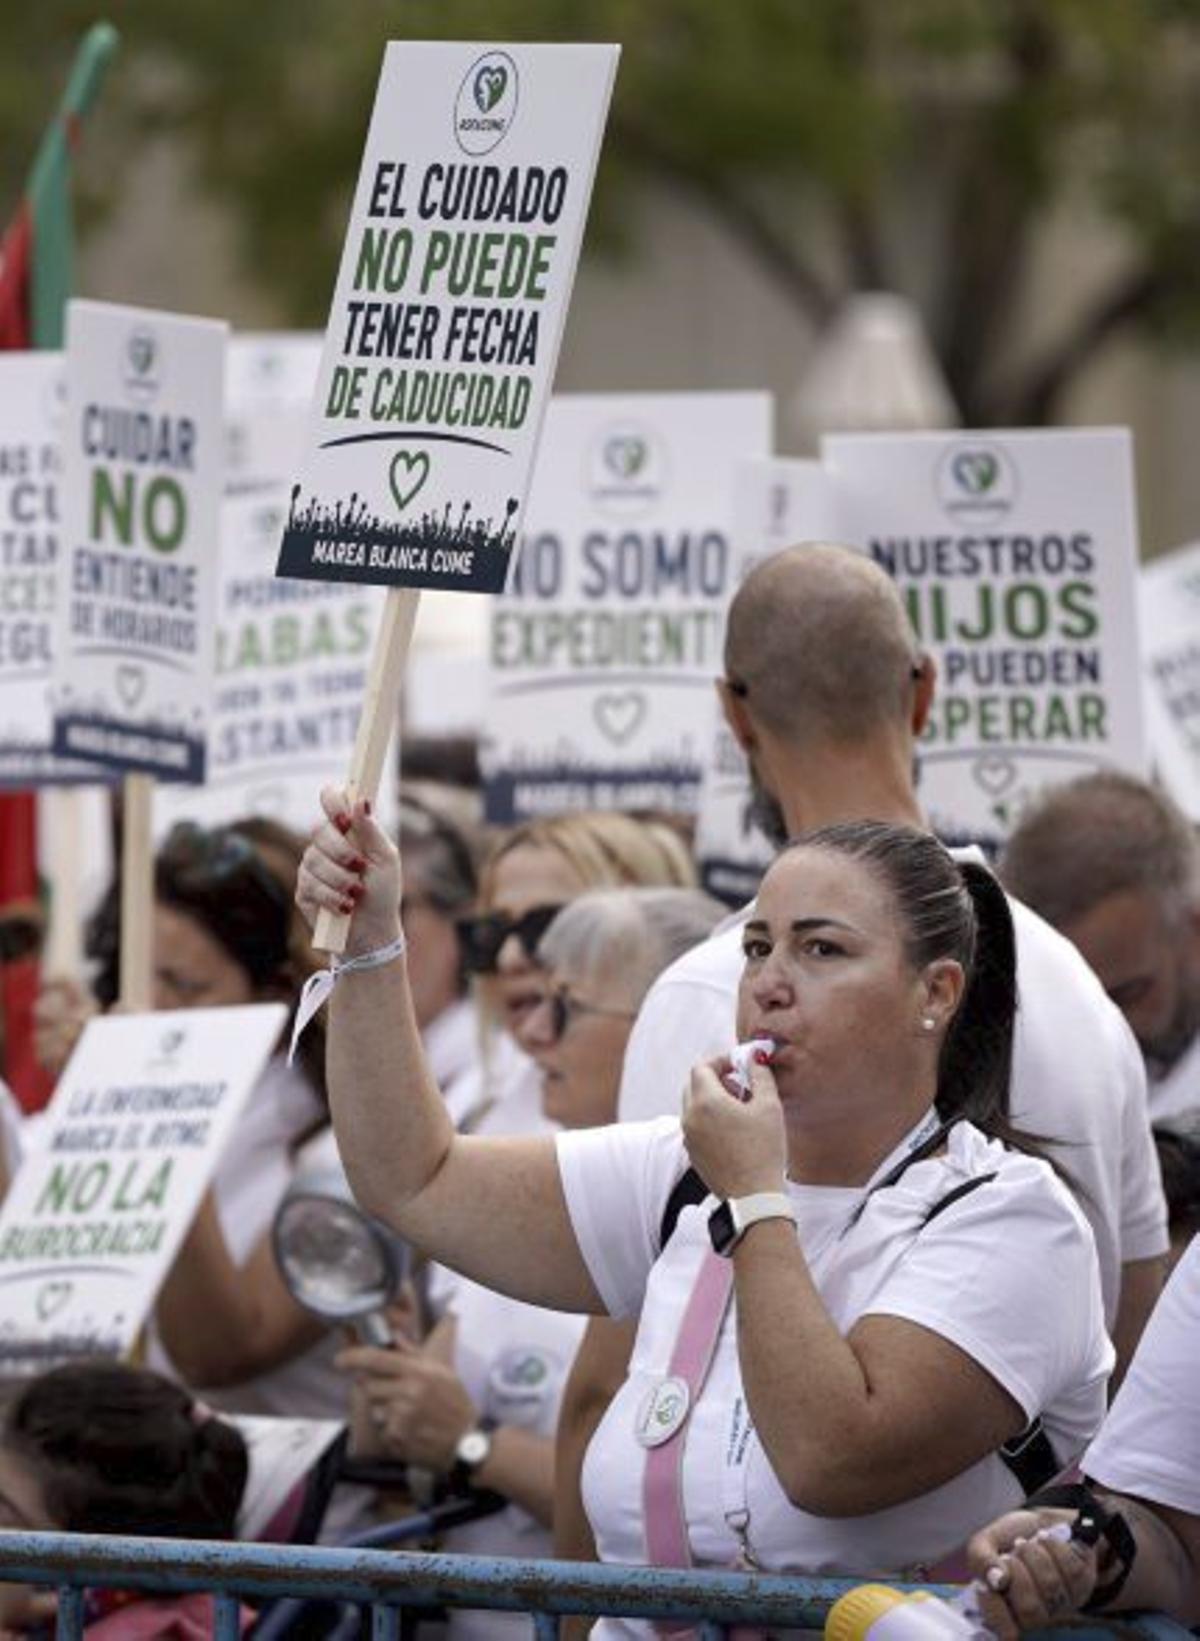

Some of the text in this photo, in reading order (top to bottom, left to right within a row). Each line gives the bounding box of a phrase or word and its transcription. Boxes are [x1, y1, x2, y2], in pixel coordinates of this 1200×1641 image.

[368, 161, 568, 225] EL CUIDADO
[353, 227, 557, 300] NO PUEDE
[343, 301, 540, 366] TENER FECHA
[325, 366, 532, 429] DE CADUCIDAD
[90, 464, 187, 552] NO
[312, 540, 474, 575] MAREA BLANCA CUME
[582, 530, 728, 598] SOMO
[869, 535, 1093, 577] NUESTROS
[945, 650, 1099, 686] PUEDEN
[33, 1156, 174, 1215] NO LA
